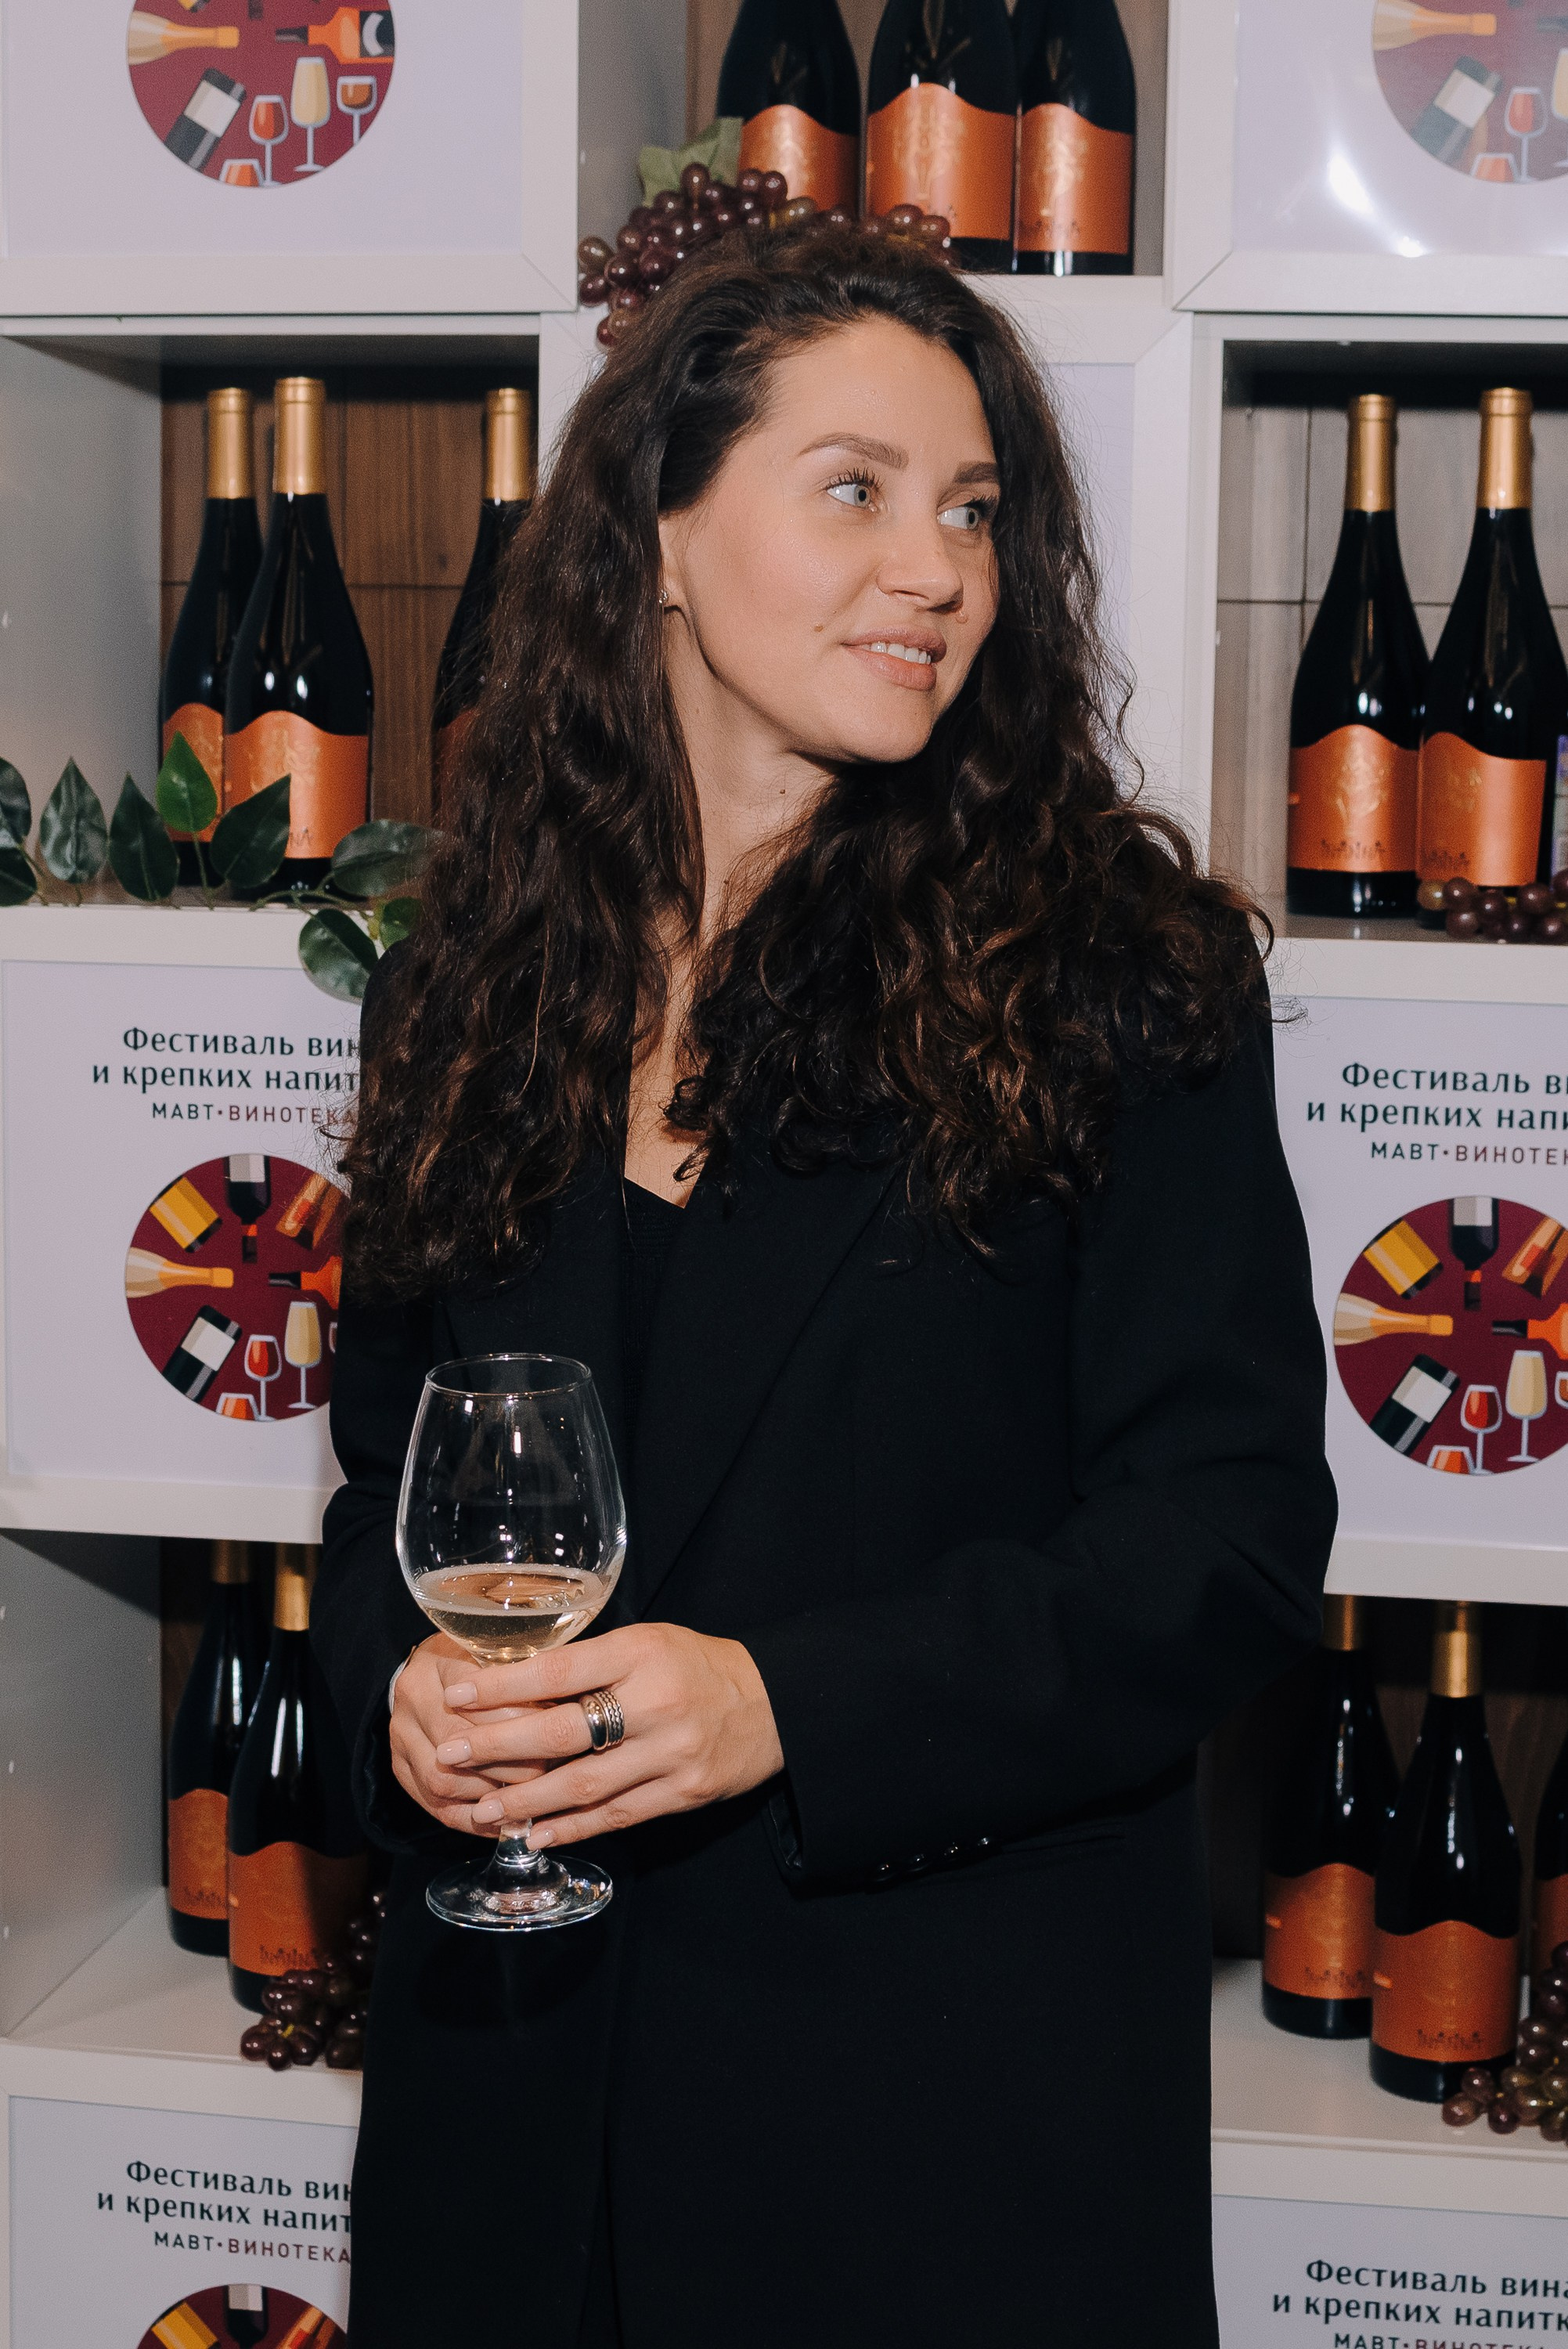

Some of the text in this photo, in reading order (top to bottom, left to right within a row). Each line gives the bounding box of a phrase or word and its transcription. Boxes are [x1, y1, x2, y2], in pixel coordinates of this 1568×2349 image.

[123, 1027, 294, 1056] Фестиваль
[92, 1065, 359, 1095] и крепких напит
[1342, 1063, 1568, 1095] Фестиваль в
[1307, 1102, 1325, 1123] и
[1339, 1103, 1482, 1133] крепких
[126, 2160, 292, 2197] Фестиваль
[97, 2192, 351, 2233] и крепких напит
[1306, 2259, 1488, 2295] Фестиваль
[1272, 2294, 1291, 2314] и
[1304, 2297, 1441, 2326] крепких
